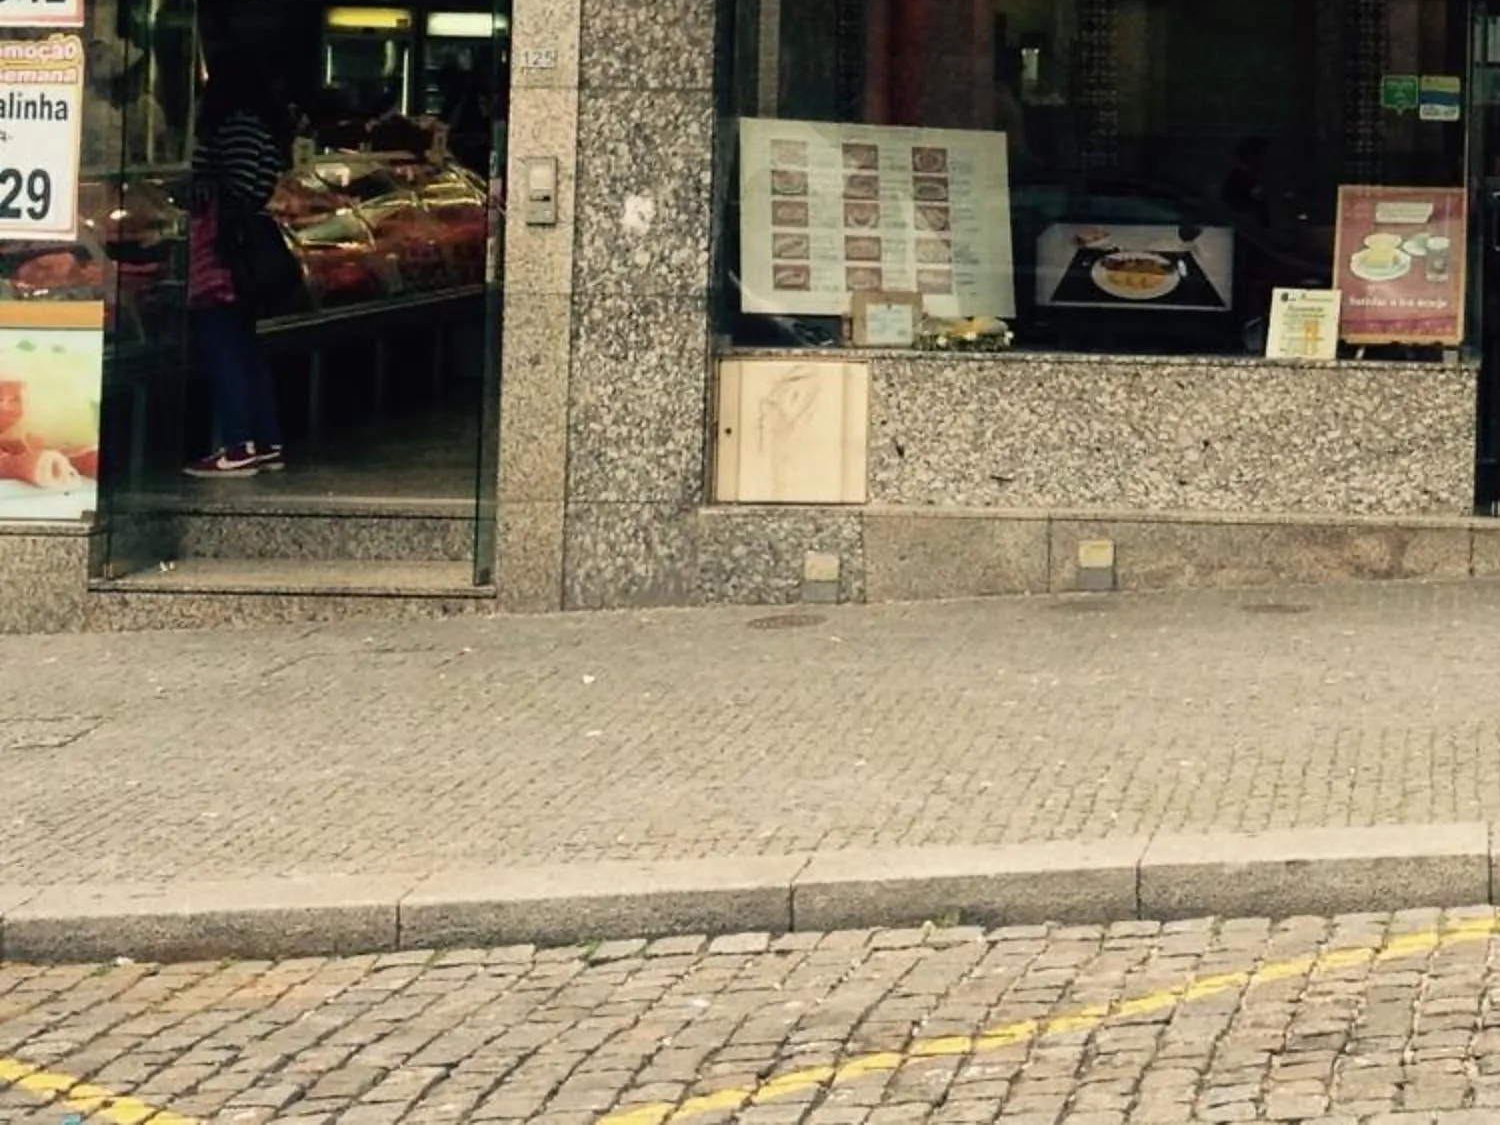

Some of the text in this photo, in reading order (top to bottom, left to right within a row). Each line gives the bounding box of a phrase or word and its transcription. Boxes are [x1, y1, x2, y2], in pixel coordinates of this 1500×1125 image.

[0, 35, 78, 62] moção
[0, 67, 79, 83] emana
[0, 168, 52, 221] 29
